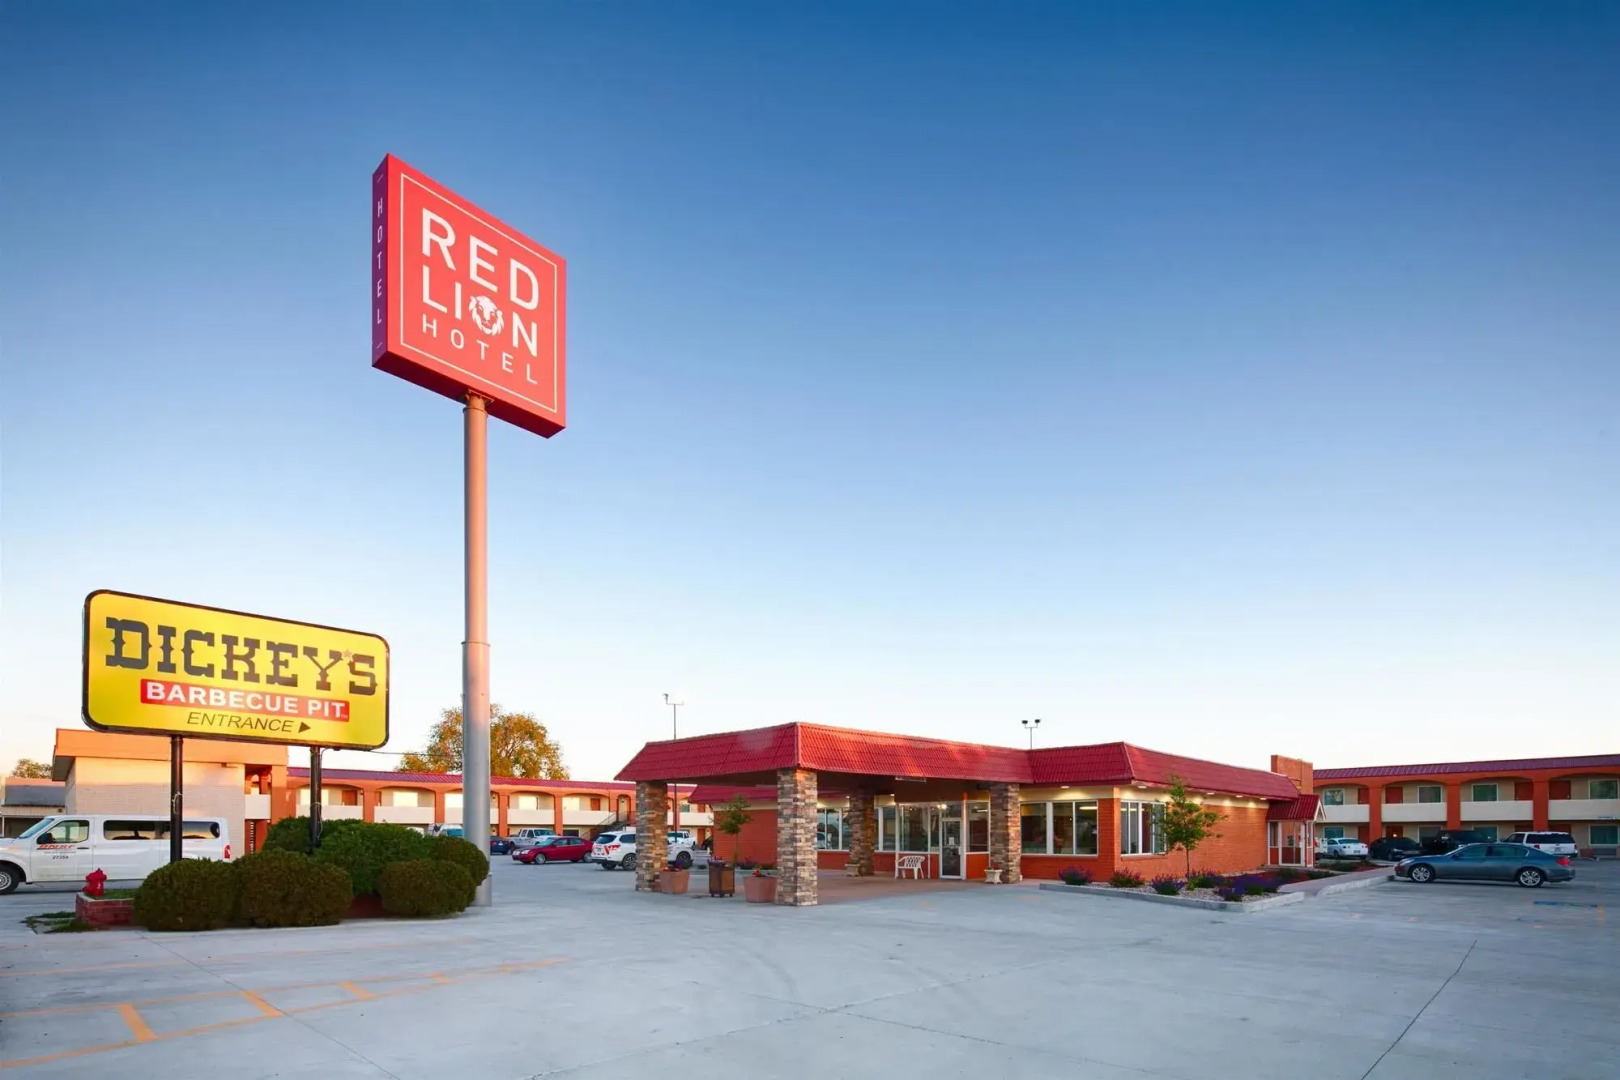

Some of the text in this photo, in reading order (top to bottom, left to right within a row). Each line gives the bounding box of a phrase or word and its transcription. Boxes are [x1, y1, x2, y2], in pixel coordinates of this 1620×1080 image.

[422, 208, 539, 311] RED
[422, 313, 538, 384] HOTEL
[105, 616, 377, 696] DICKEY'S
[146, 681, 345, 718] BARBECUE PIT
[187, 711, 294, 732] ENTRANCE
